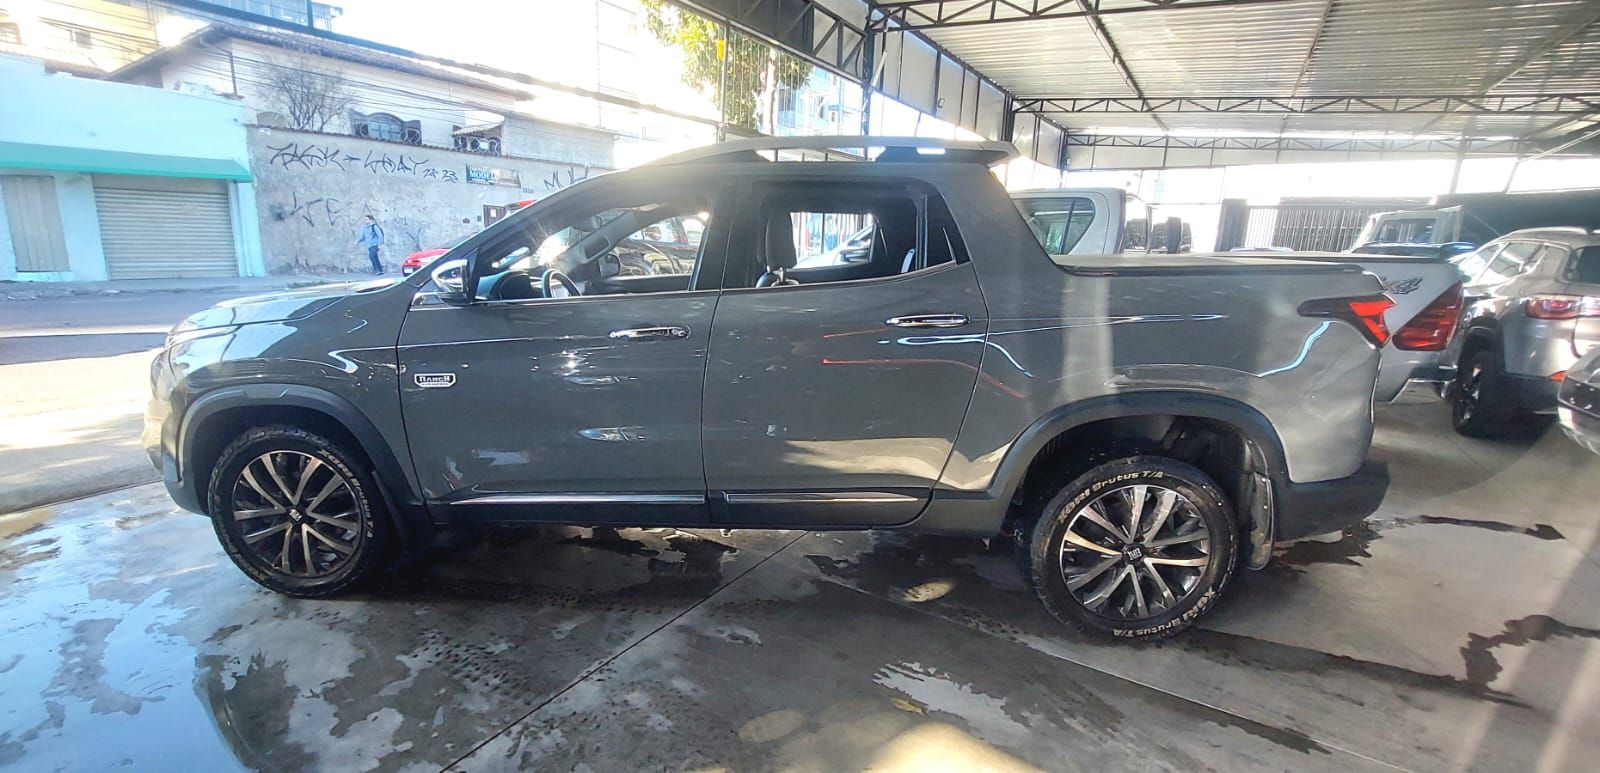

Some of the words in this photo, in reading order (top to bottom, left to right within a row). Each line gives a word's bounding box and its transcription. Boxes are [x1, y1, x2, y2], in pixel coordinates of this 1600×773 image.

[1092, 472, 1139, 492] Brutus
[1142, 470, 1164, 479] T/A
[1113, 627, 1134, 637] T/A
